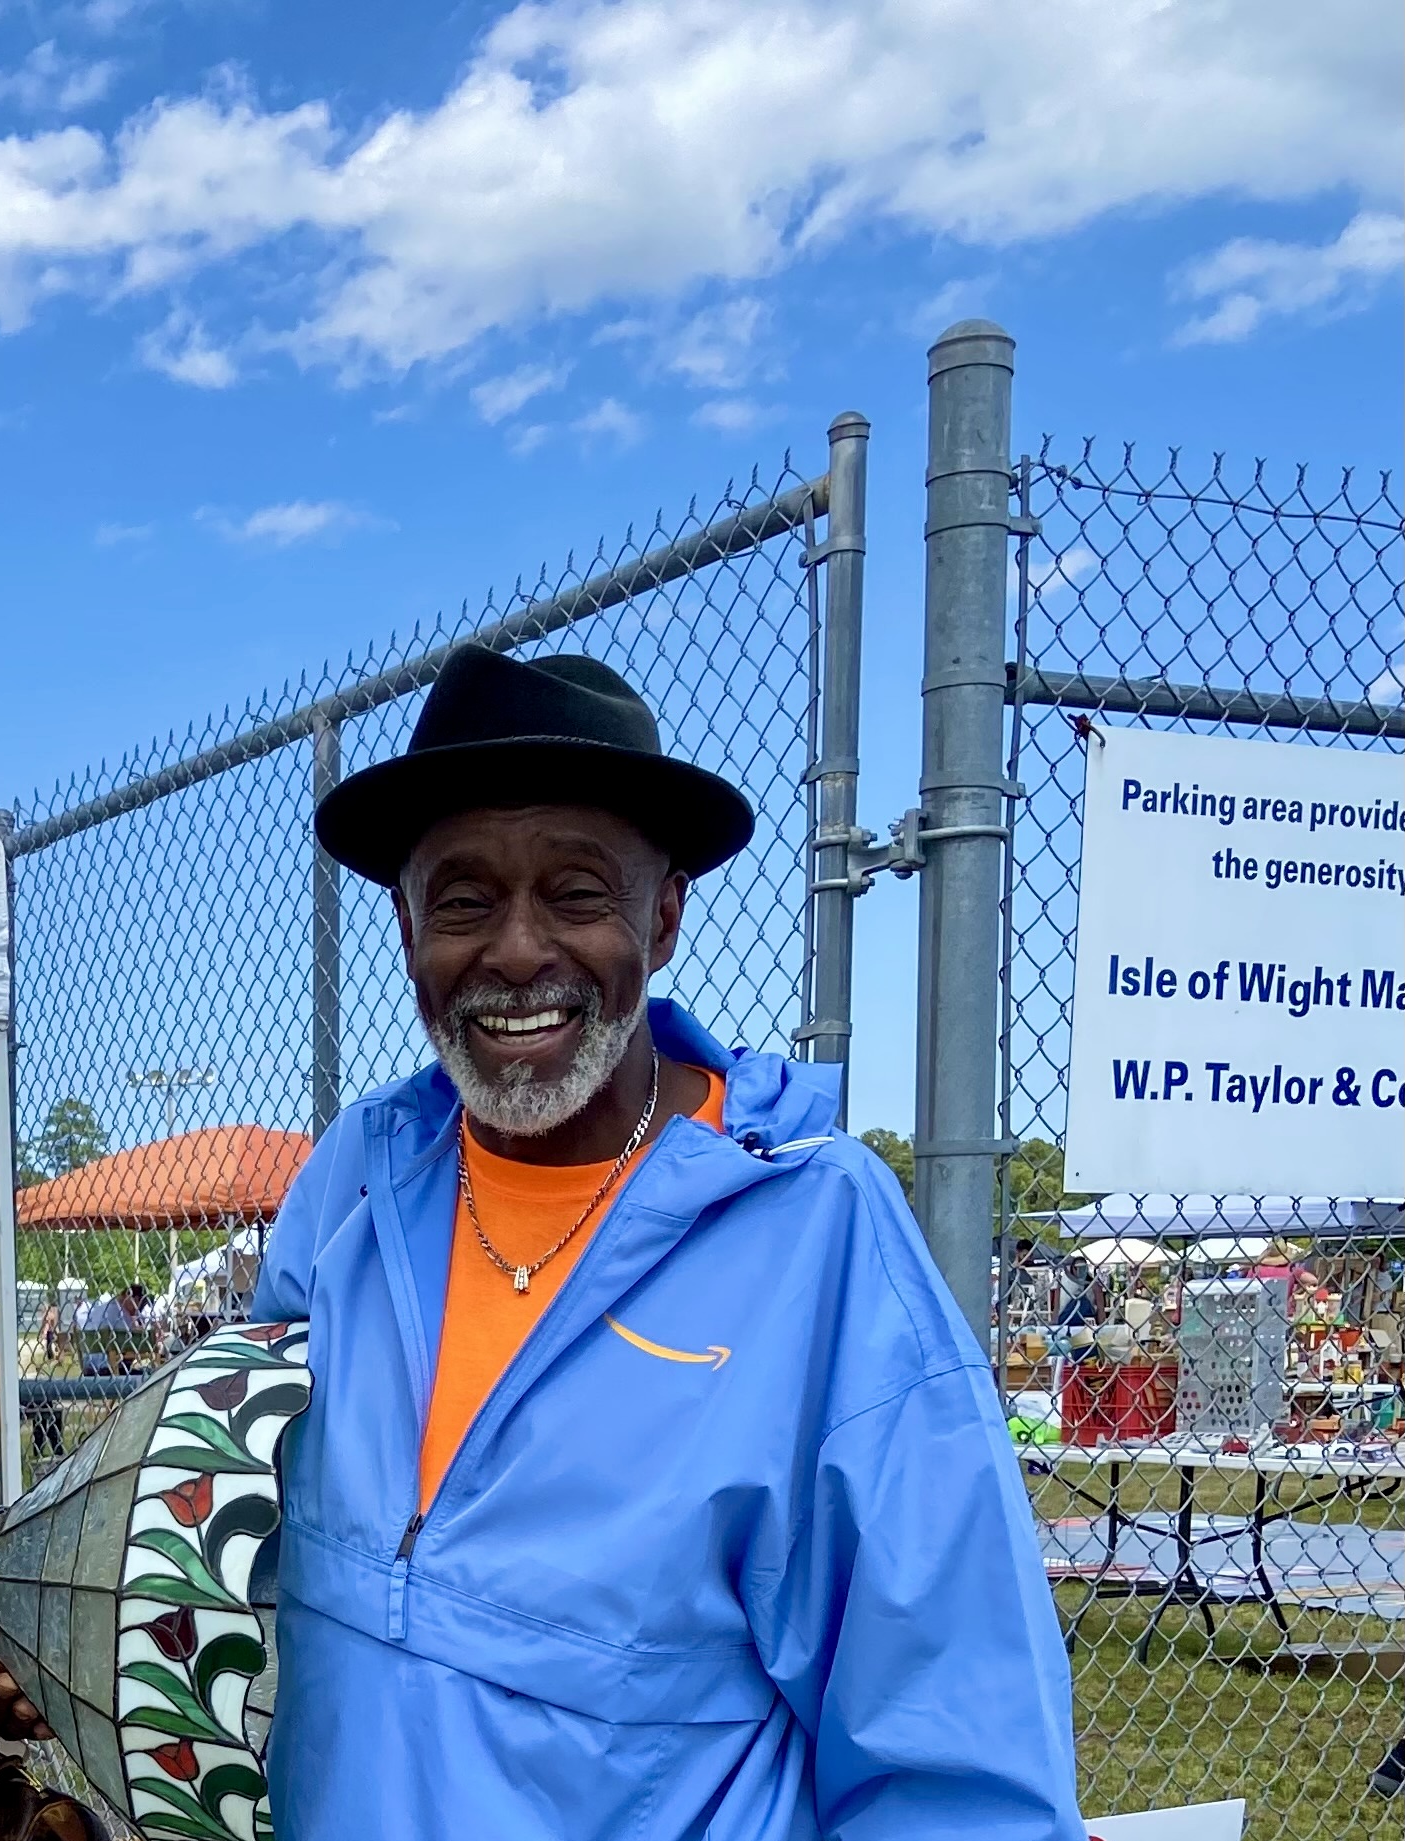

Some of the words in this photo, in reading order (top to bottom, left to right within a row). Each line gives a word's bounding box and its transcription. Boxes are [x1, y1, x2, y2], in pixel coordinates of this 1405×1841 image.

[1122, 778, 1236, 826] Parking
[1242, 797, 1303, 823] area
[1212, 847, 1258, 881] the
[1108, 954, 1177, 998] Isle
[1187, 960, 1230, 1001] of
[1238, 961, 1352, 1018] Wight
[1112, 1059, 1193, 1102] W.P.
[1205, 1062, 1324, 1113] Taylor
[1331, 1066, 1362, 1107] &
